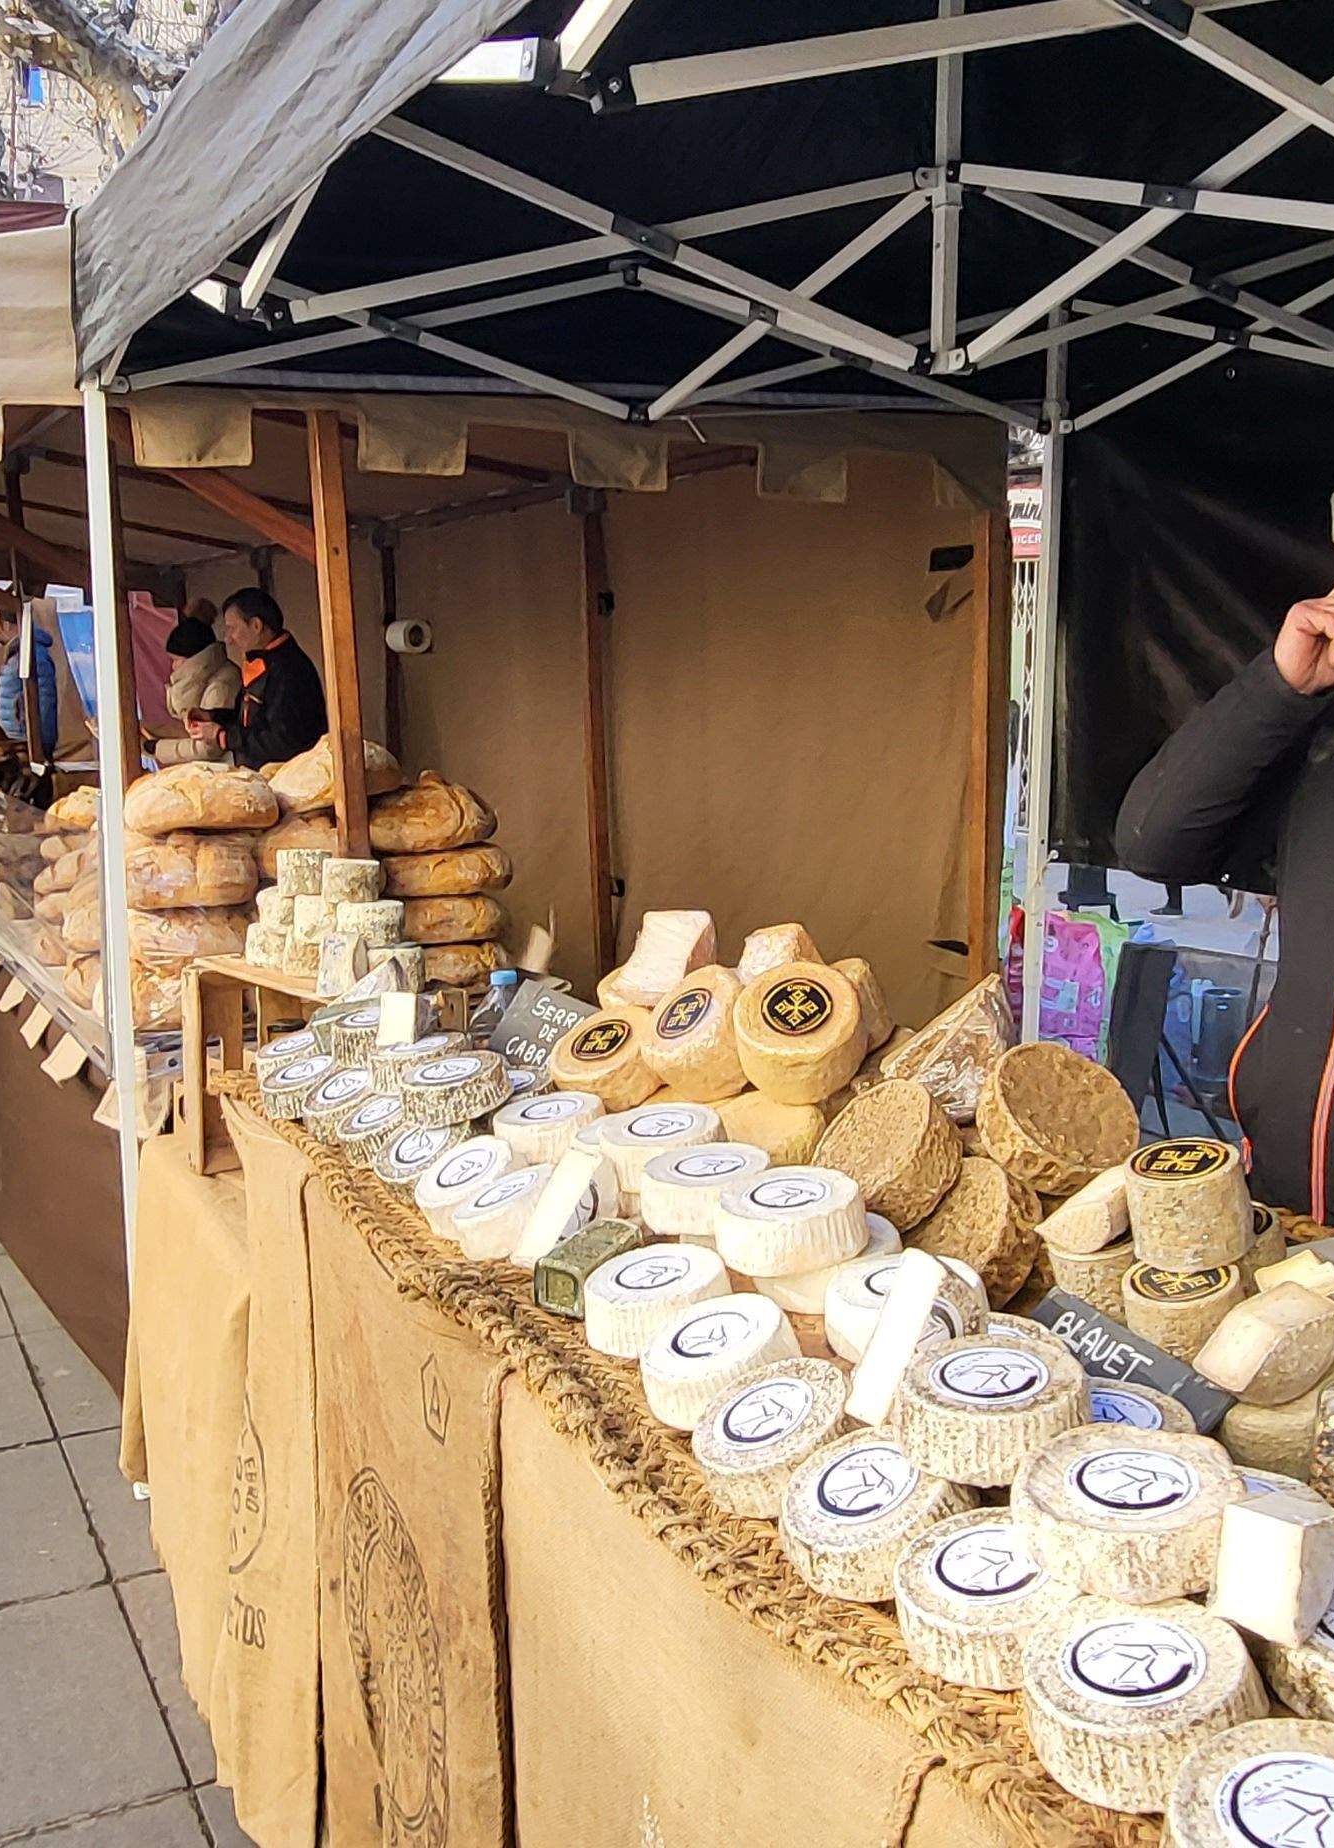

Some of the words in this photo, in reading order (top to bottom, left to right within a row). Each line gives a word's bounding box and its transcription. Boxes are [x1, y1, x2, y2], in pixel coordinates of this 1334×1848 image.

[538, 1024, 558, 1043] DE
[505, 1036, 549, 1066] CABR
[1050, 1311, 1155, 1382] BLAUET
